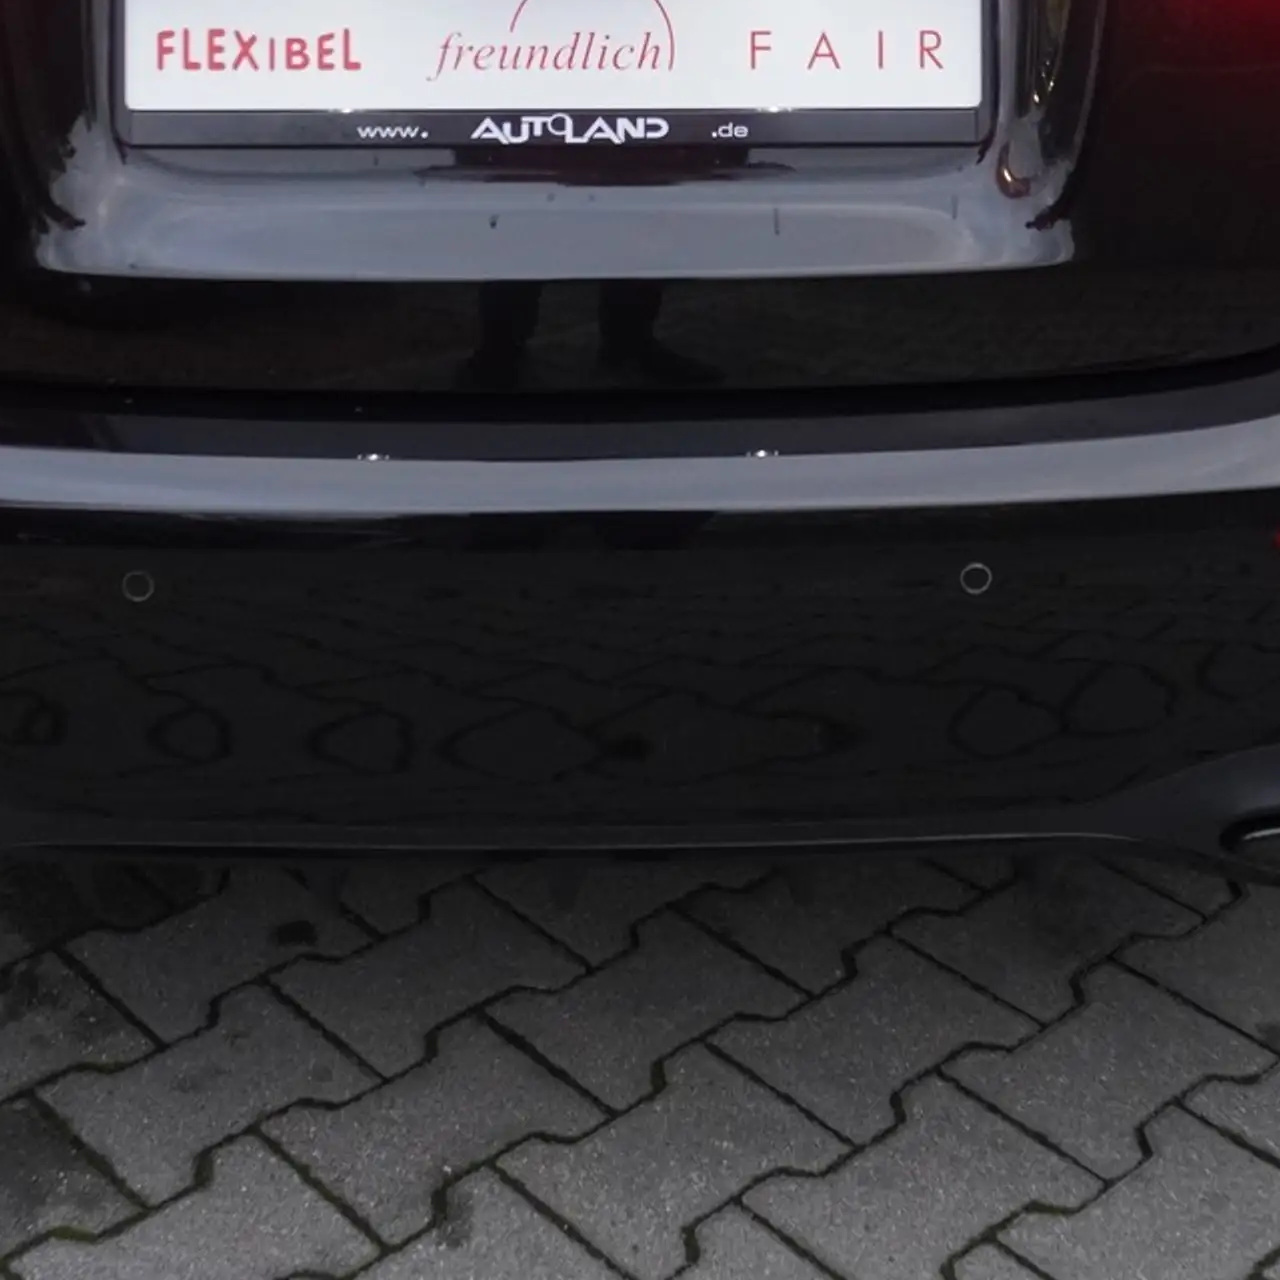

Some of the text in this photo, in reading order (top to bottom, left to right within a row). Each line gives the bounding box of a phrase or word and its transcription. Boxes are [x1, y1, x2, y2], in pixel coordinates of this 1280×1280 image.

[157, 28, 944, 82] FLEXIBEL freundlich FAIR
[356, 112, 750, 145] www. AUTOLAND .de
